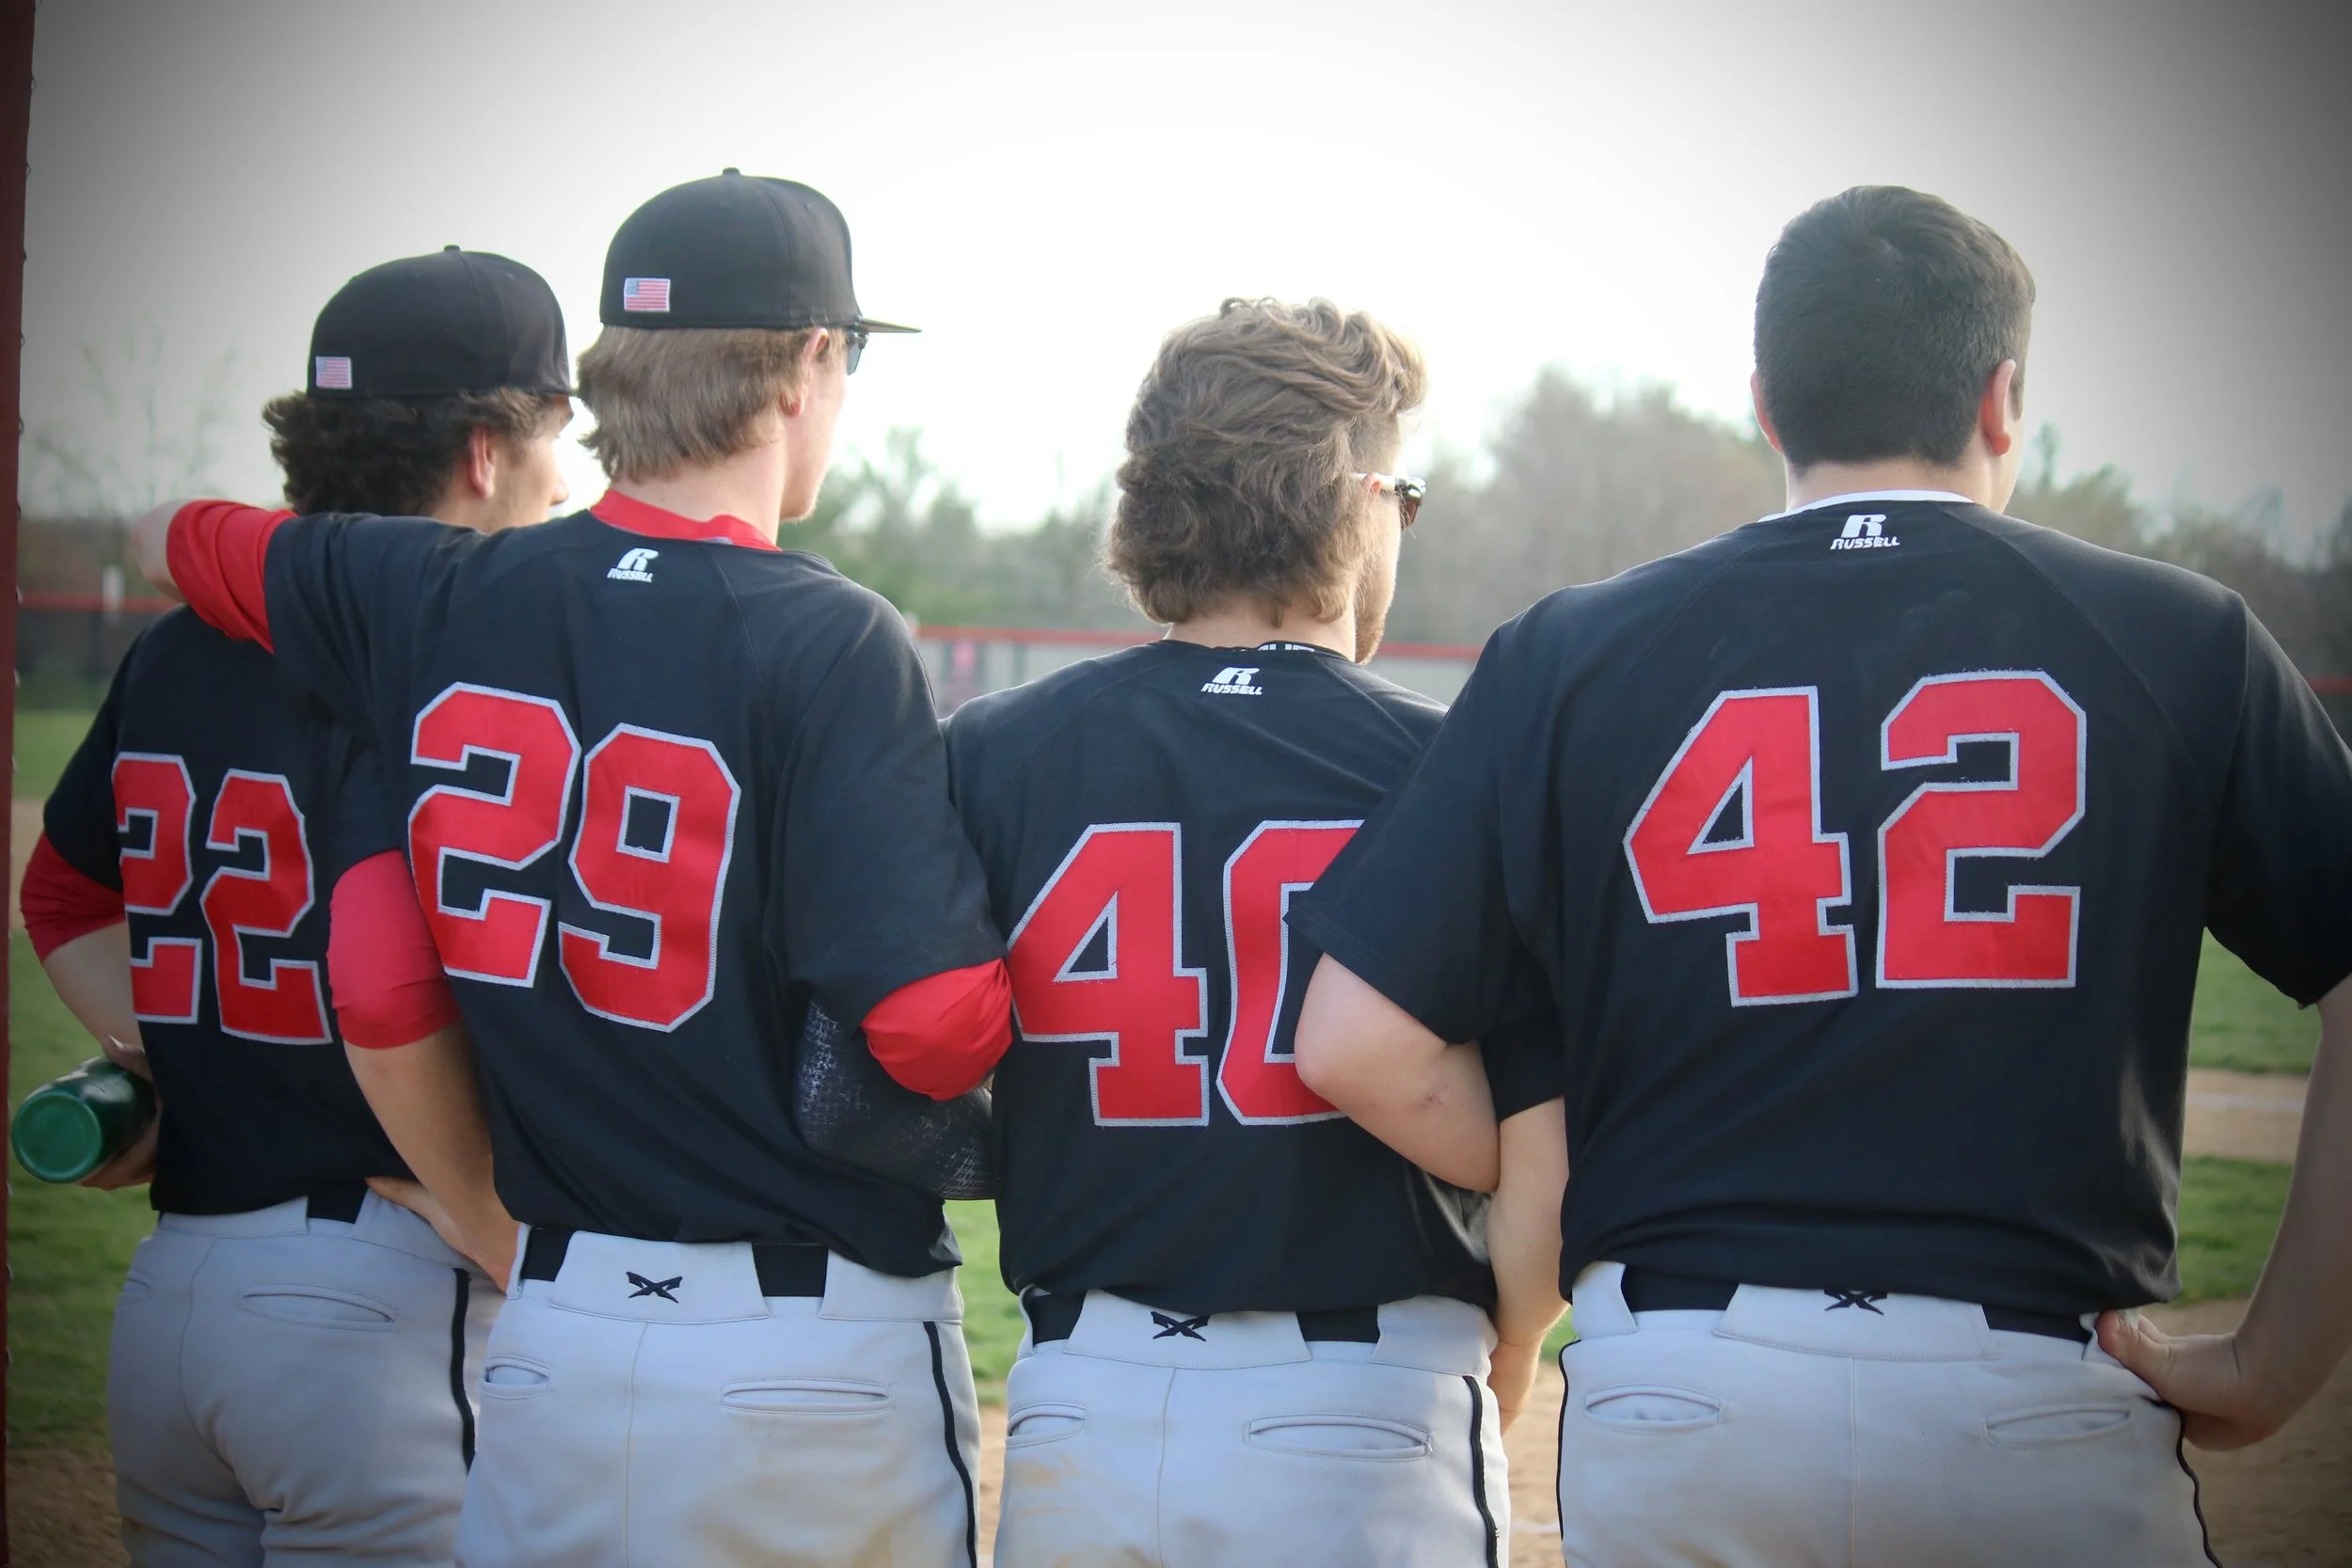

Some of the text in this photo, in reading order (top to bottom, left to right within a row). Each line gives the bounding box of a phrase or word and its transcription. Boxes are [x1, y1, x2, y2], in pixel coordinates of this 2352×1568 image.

[1200, 682, 1263, 696] RUSSELL
[1830, 536, 1900, 550] RUSSELL
[111, 752, 333, 1045] 22
[408, 682, 741, 1033] 29
[1623, 669, 2087, 1007] 42
